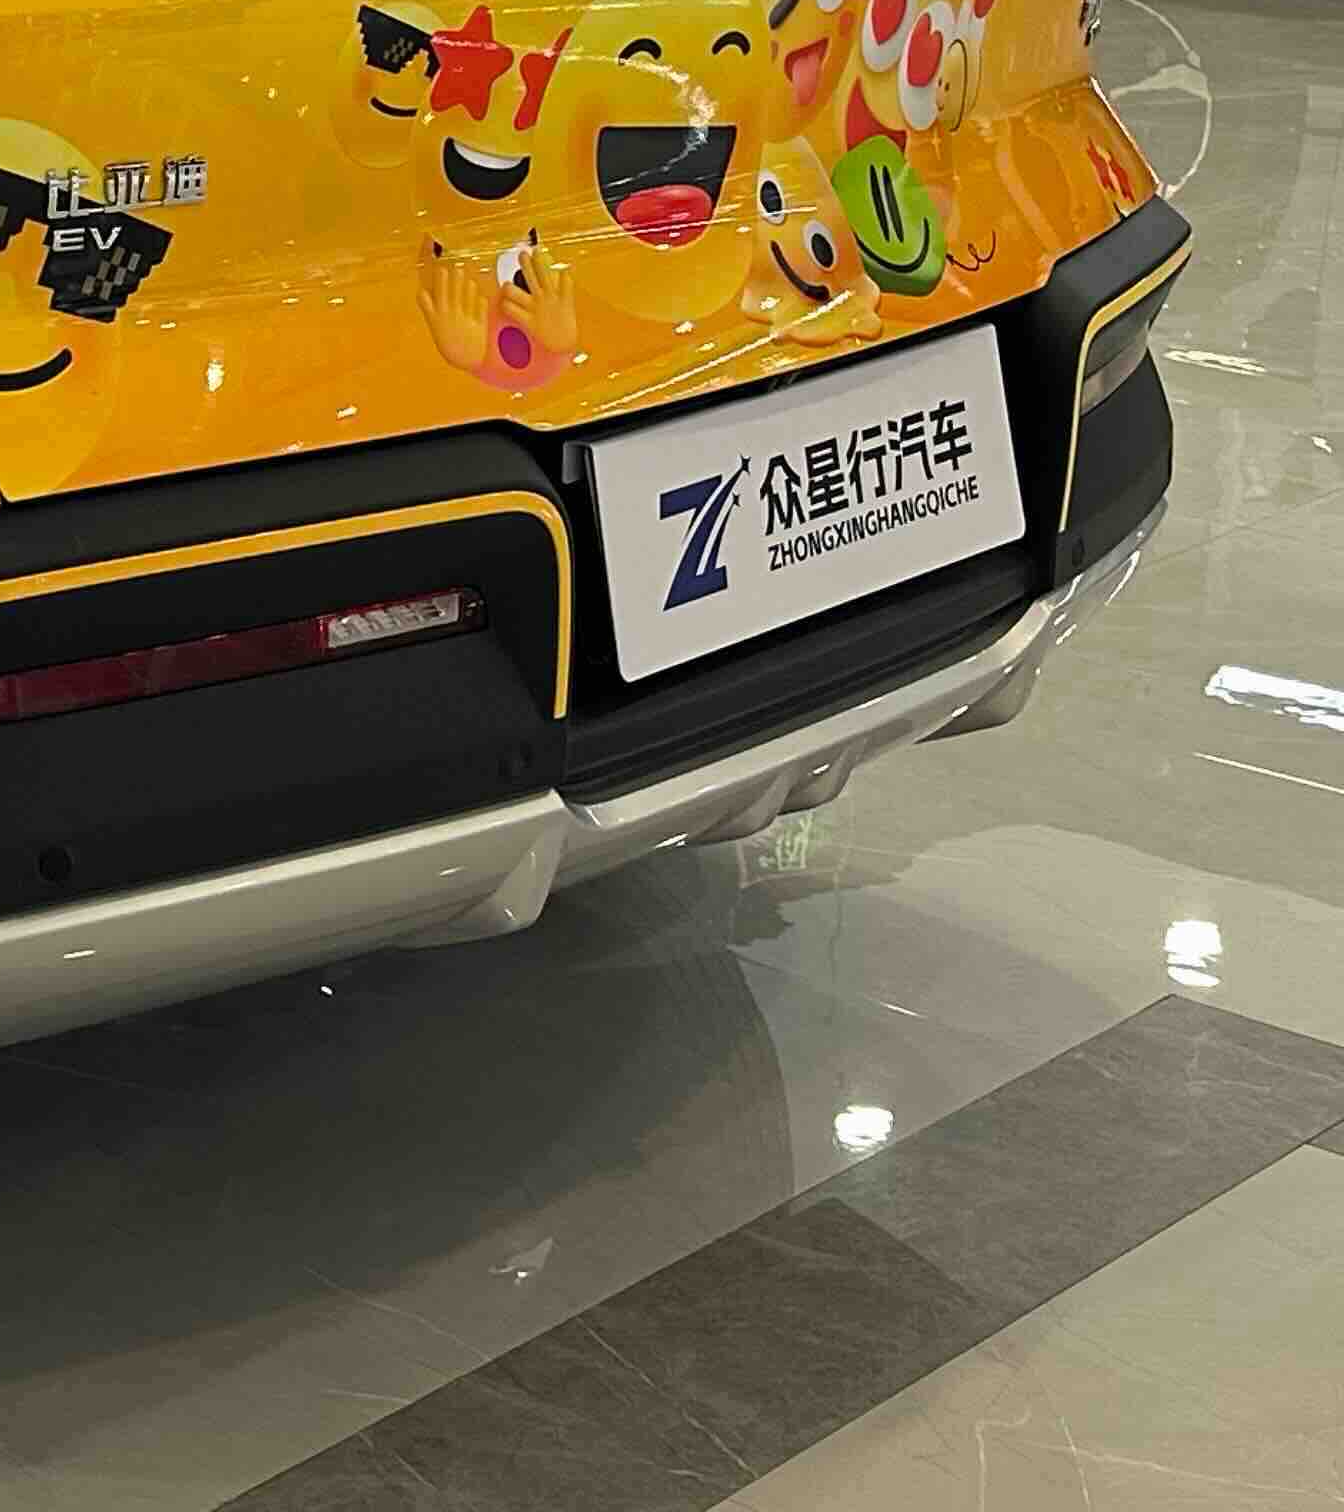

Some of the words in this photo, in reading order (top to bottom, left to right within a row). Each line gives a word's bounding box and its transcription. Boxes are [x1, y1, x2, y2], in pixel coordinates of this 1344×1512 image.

[45, 154, 209, 220] 比亚迪
[52, 225, 122, 253] EV
[759, 400, 973, 536] 众星行汽车
[768, 475, 979, 572] ZHONGXINGHANGQICHE
